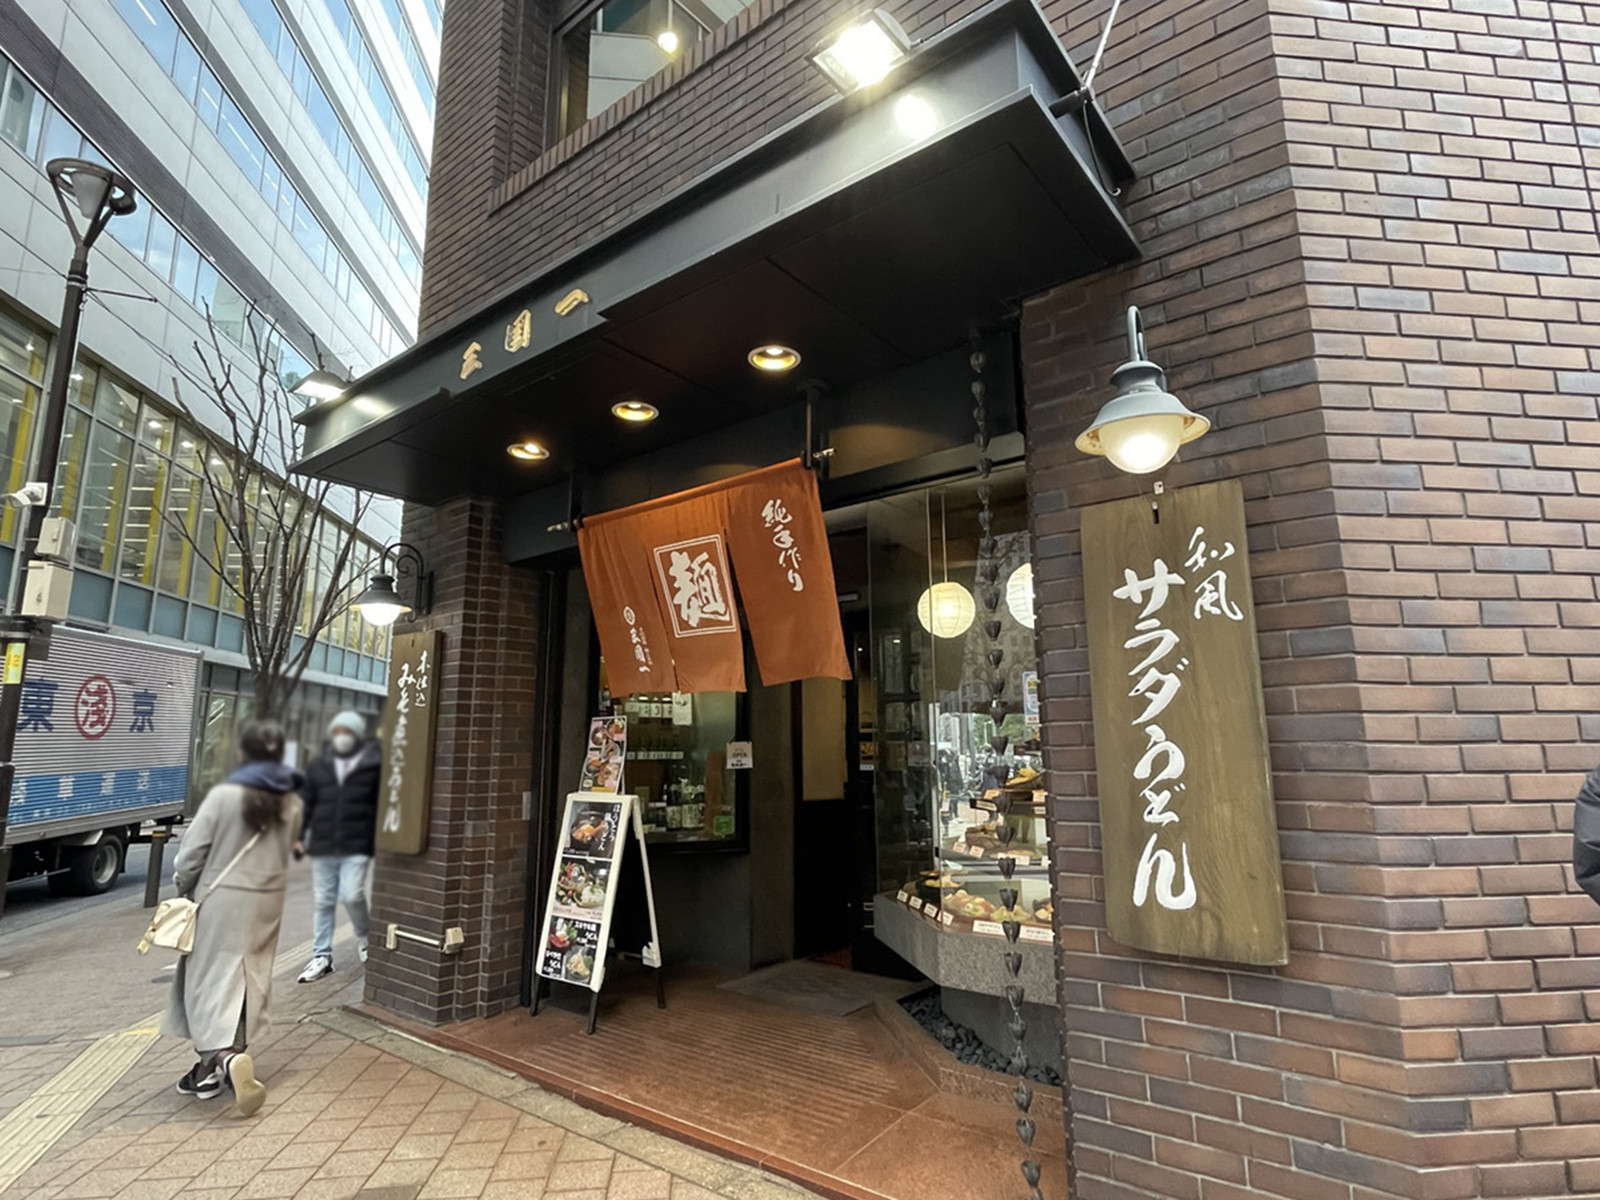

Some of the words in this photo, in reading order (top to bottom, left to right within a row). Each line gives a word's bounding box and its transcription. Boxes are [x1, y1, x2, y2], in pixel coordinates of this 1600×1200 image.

[1184, 526, 1243, 621] 和風
[1113, 558, 1197, 910] サラダうどん
